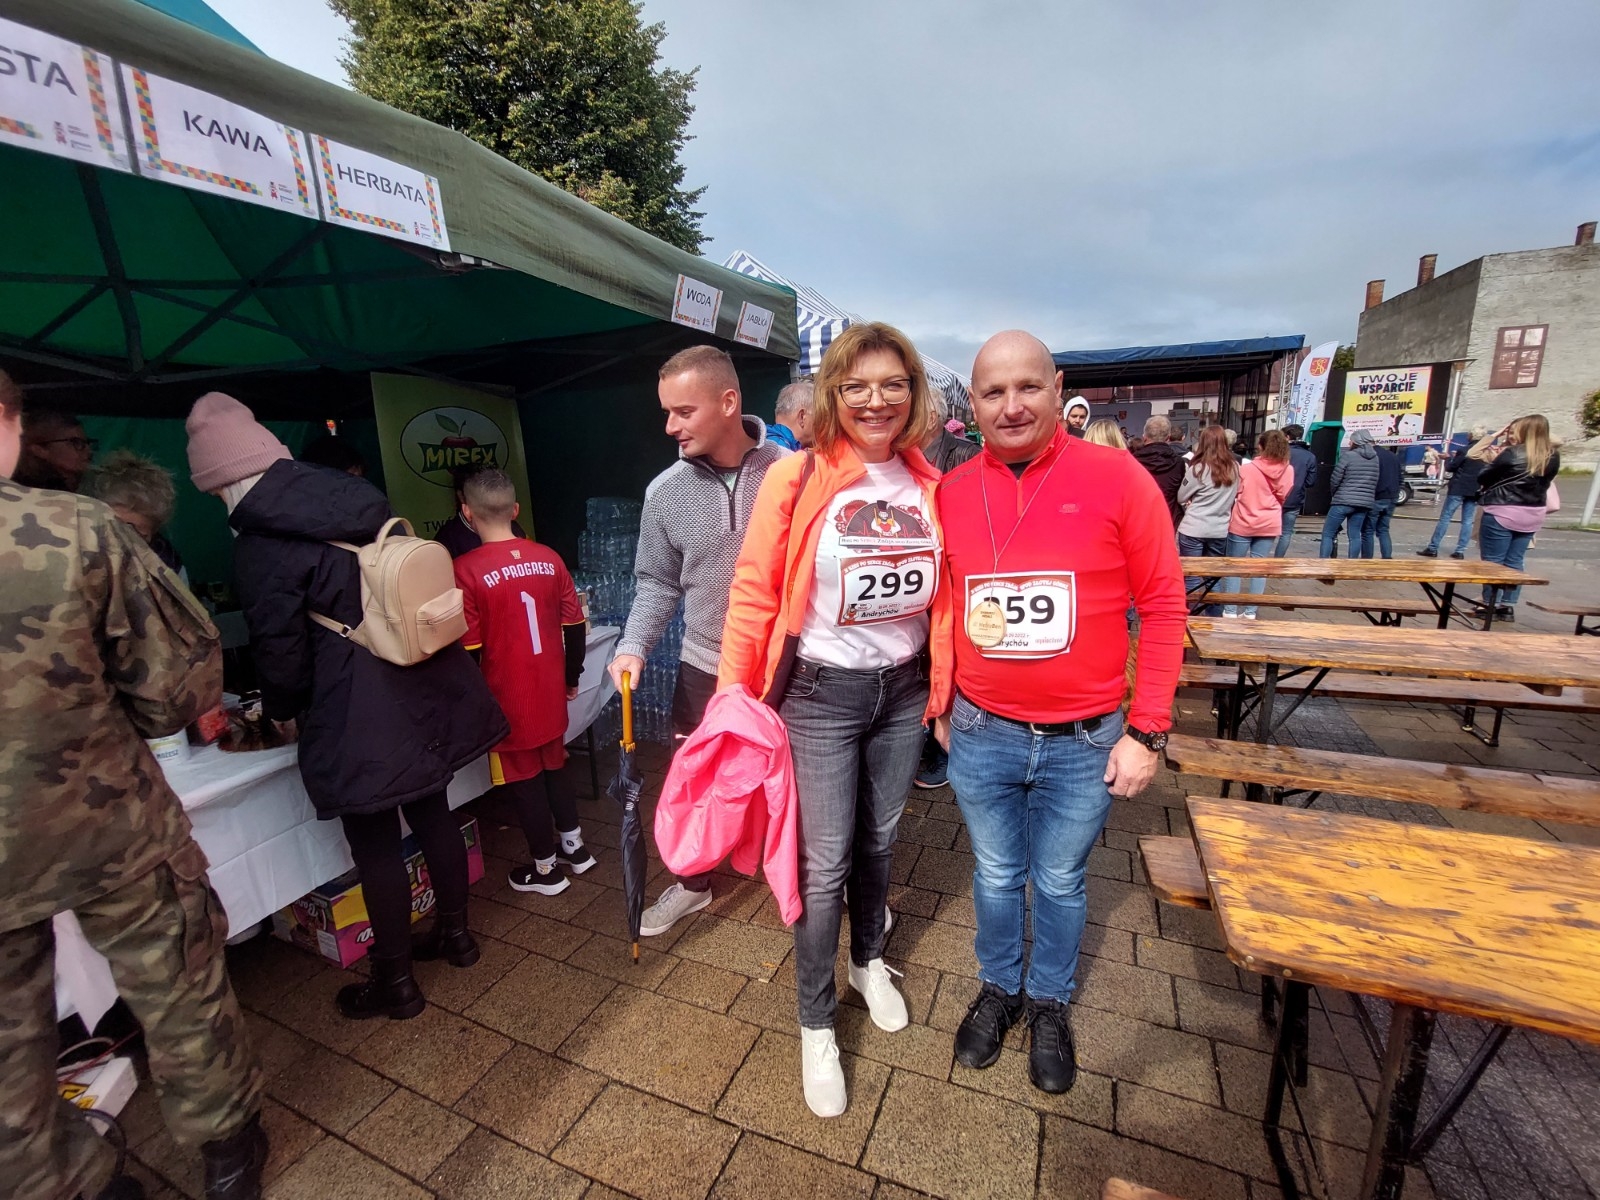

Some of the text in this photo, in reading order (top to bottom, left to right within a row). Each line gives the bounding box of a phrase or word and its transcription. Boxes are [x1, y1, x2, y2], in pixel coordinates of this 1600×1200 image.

[183, 110, 272, 157] KAWA
[337, 163, 426, 206] HERBATA
[686, 288, 711, 307] WODA
[1358, 372, 1418, 383] TWOJE
[1359, 382, 1415, 394] WSPARCIE
[1356, 399, 1413, 412] COŚ ZMIENIĆ
[483, 562, 555, 588] AP PROGRESS
[857, 569, 924, 601] 299
[520, 591, 543, 655] 1
[984, 595, 1055, 625] 59
